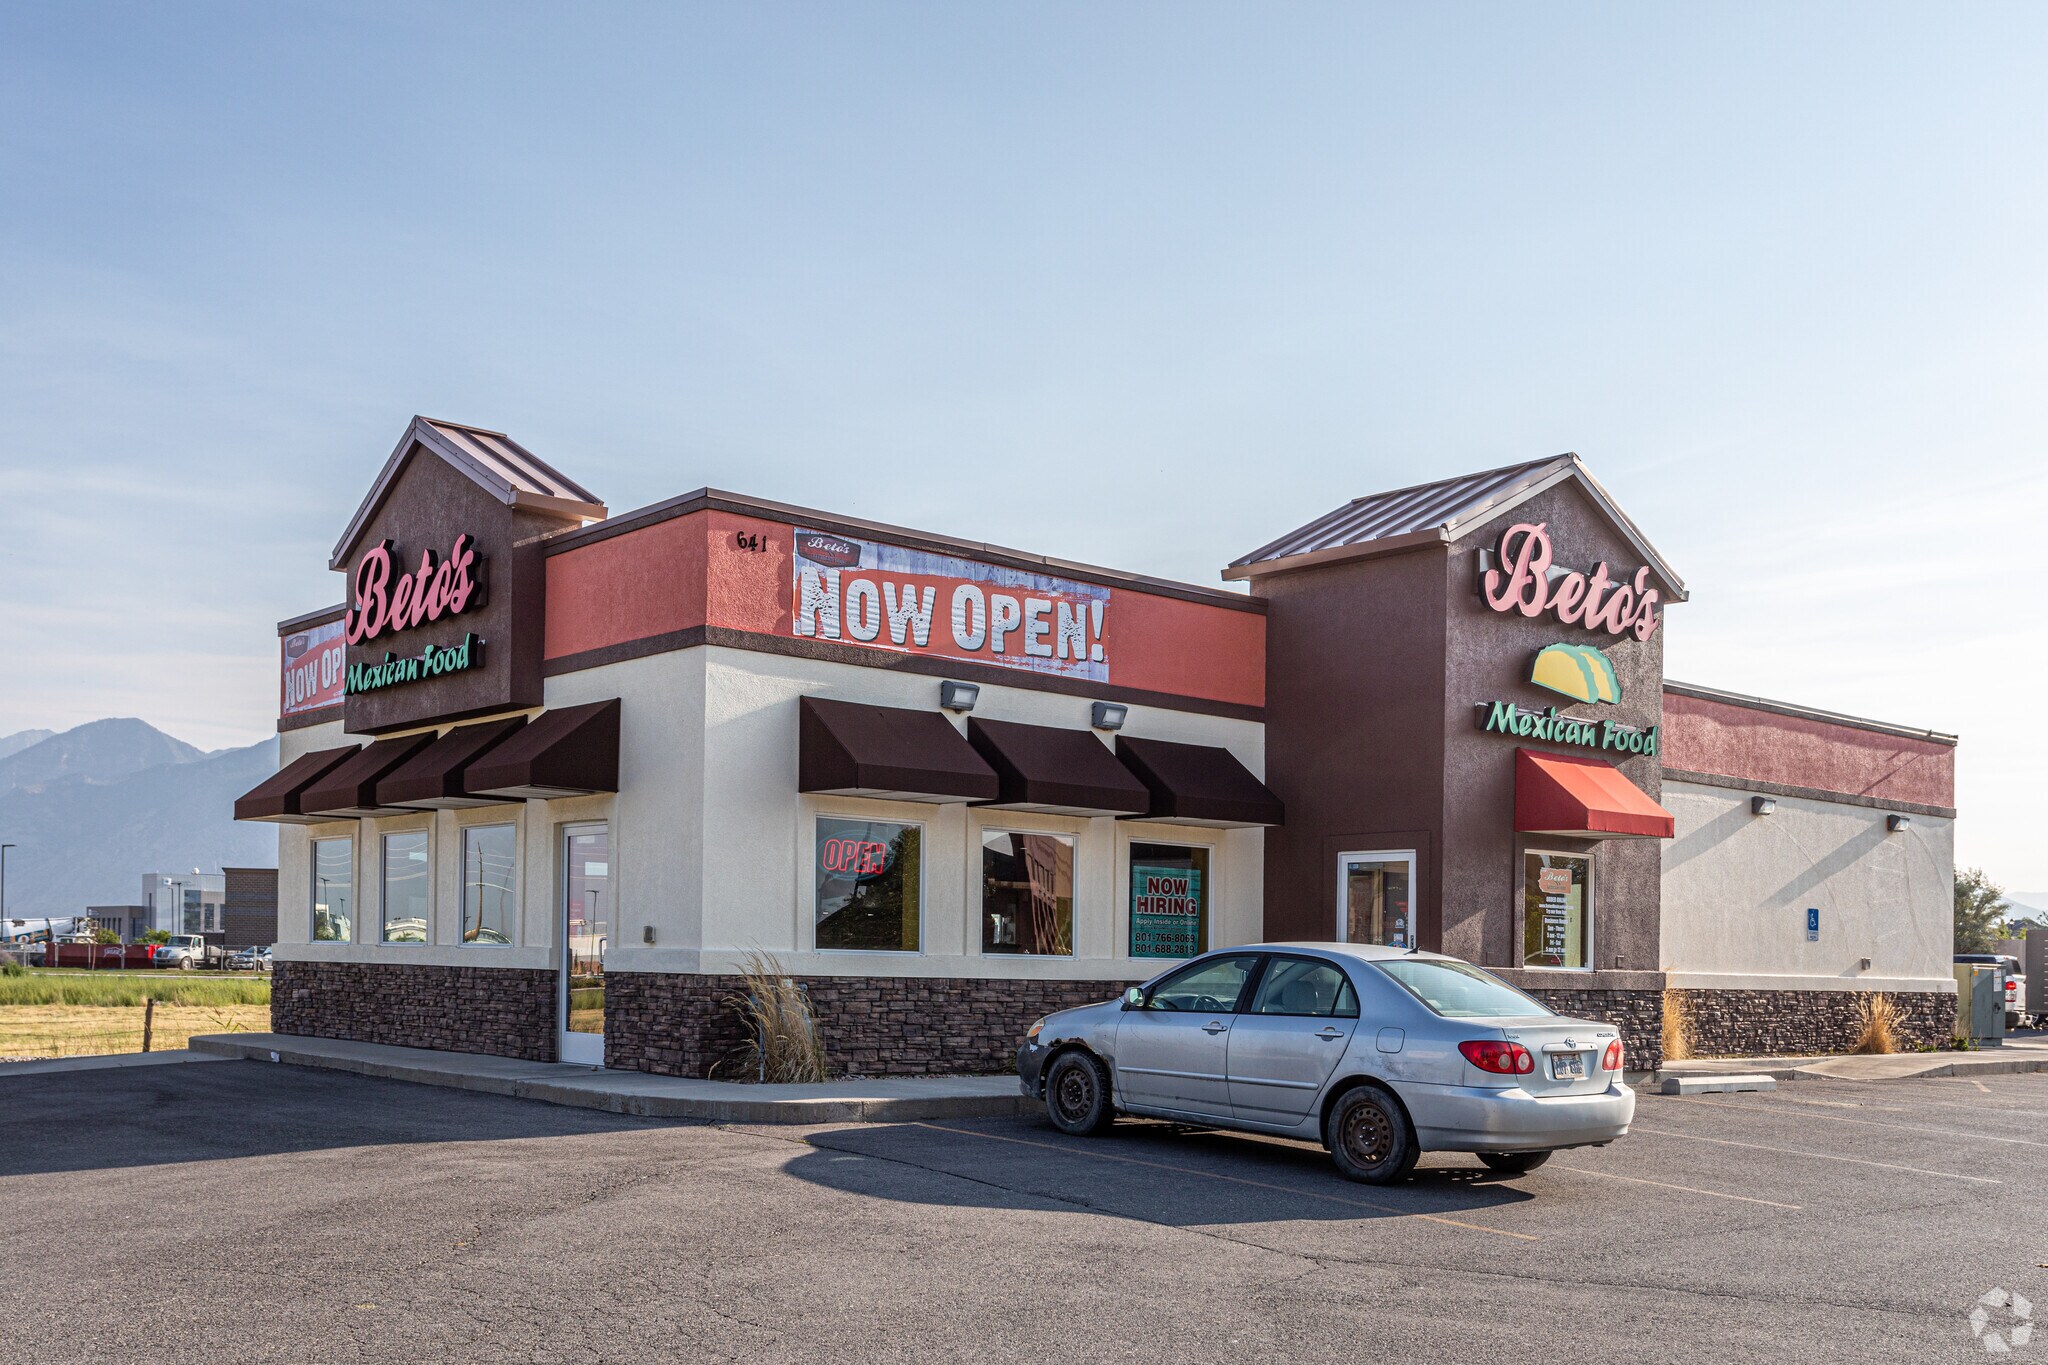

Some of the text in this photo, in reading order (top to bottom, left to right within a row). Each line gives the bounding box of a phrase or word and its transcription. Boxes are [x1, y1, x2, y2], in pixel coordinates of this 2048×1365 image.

[736, 530, 767, 553] 641
[807, 536, 850, 554] Beto's
[345, 533, 475, 646] Beto's
[1485, 522, 1660, 642] Beto's
[800, 567, 1105, 662] NOW OPEN!
[284, 659, 318, 710] NOW
[344, 632, 470, 695] Mexican Food
[1486, 700, 1658, 756] Mexican Food
[823, 839, 887, 875] OPEN
[1136, 895, 1197, 916] HIRING
[1147, 876, 1189, 896] NOW
[1135, 918, 1152, 926] Apply
